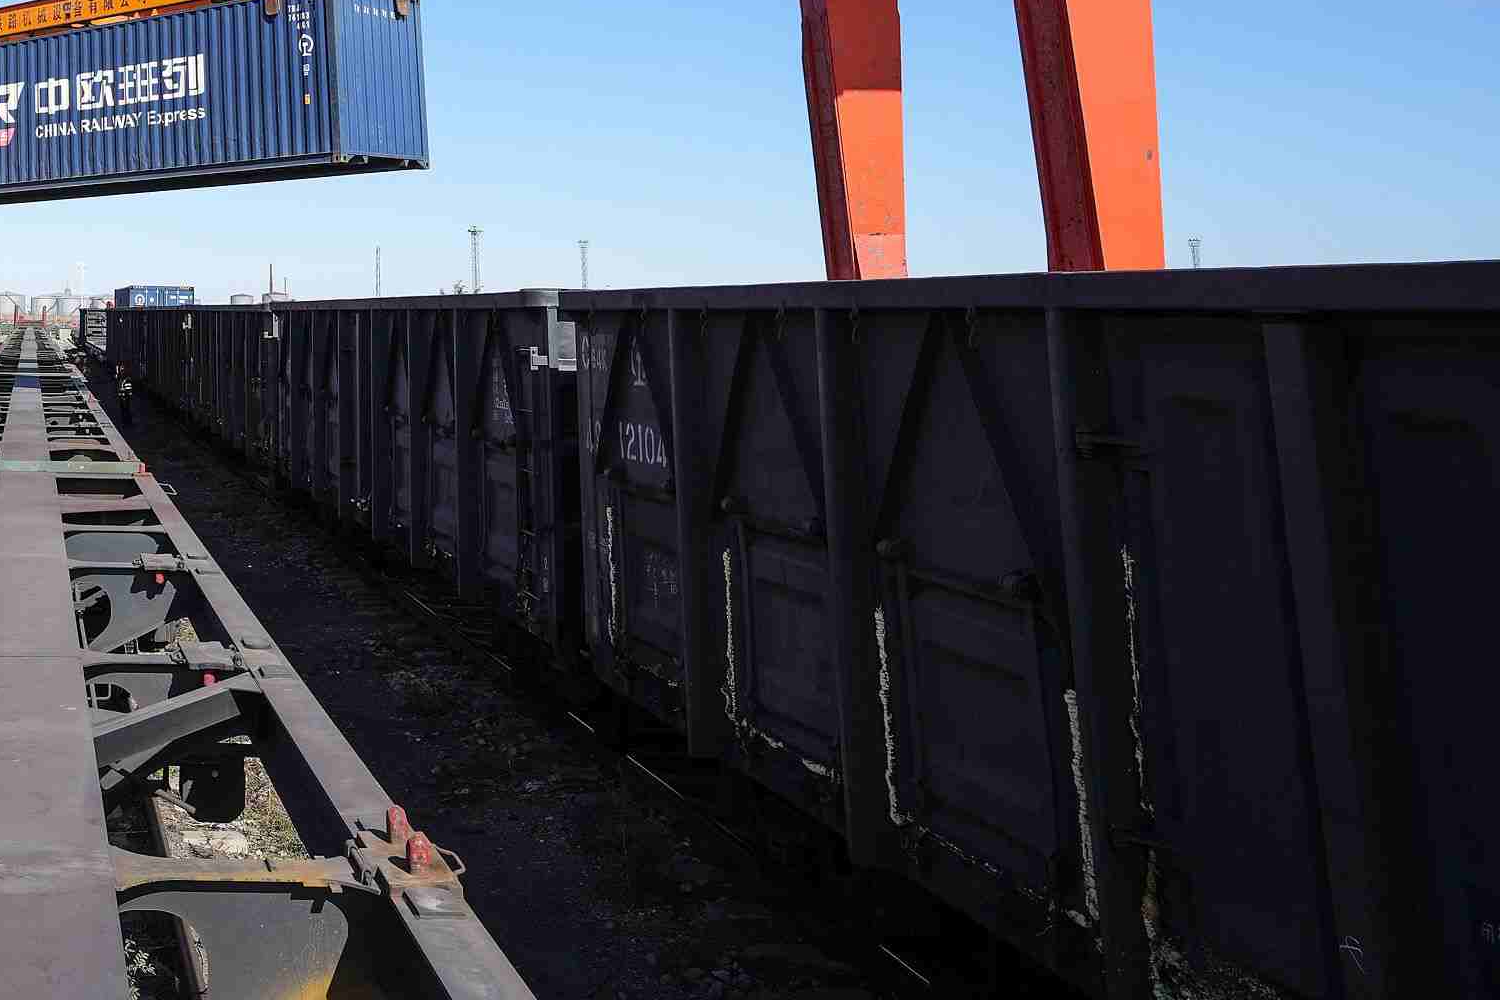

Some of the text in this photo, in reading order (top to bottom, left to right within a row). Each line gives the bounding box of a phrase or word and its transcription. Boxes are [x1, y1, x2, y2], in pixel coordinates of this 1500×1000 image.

[34, 53, 205, 115] 中欧班列
[35, 106, 206, 138] CHINA RAILWAY Express
